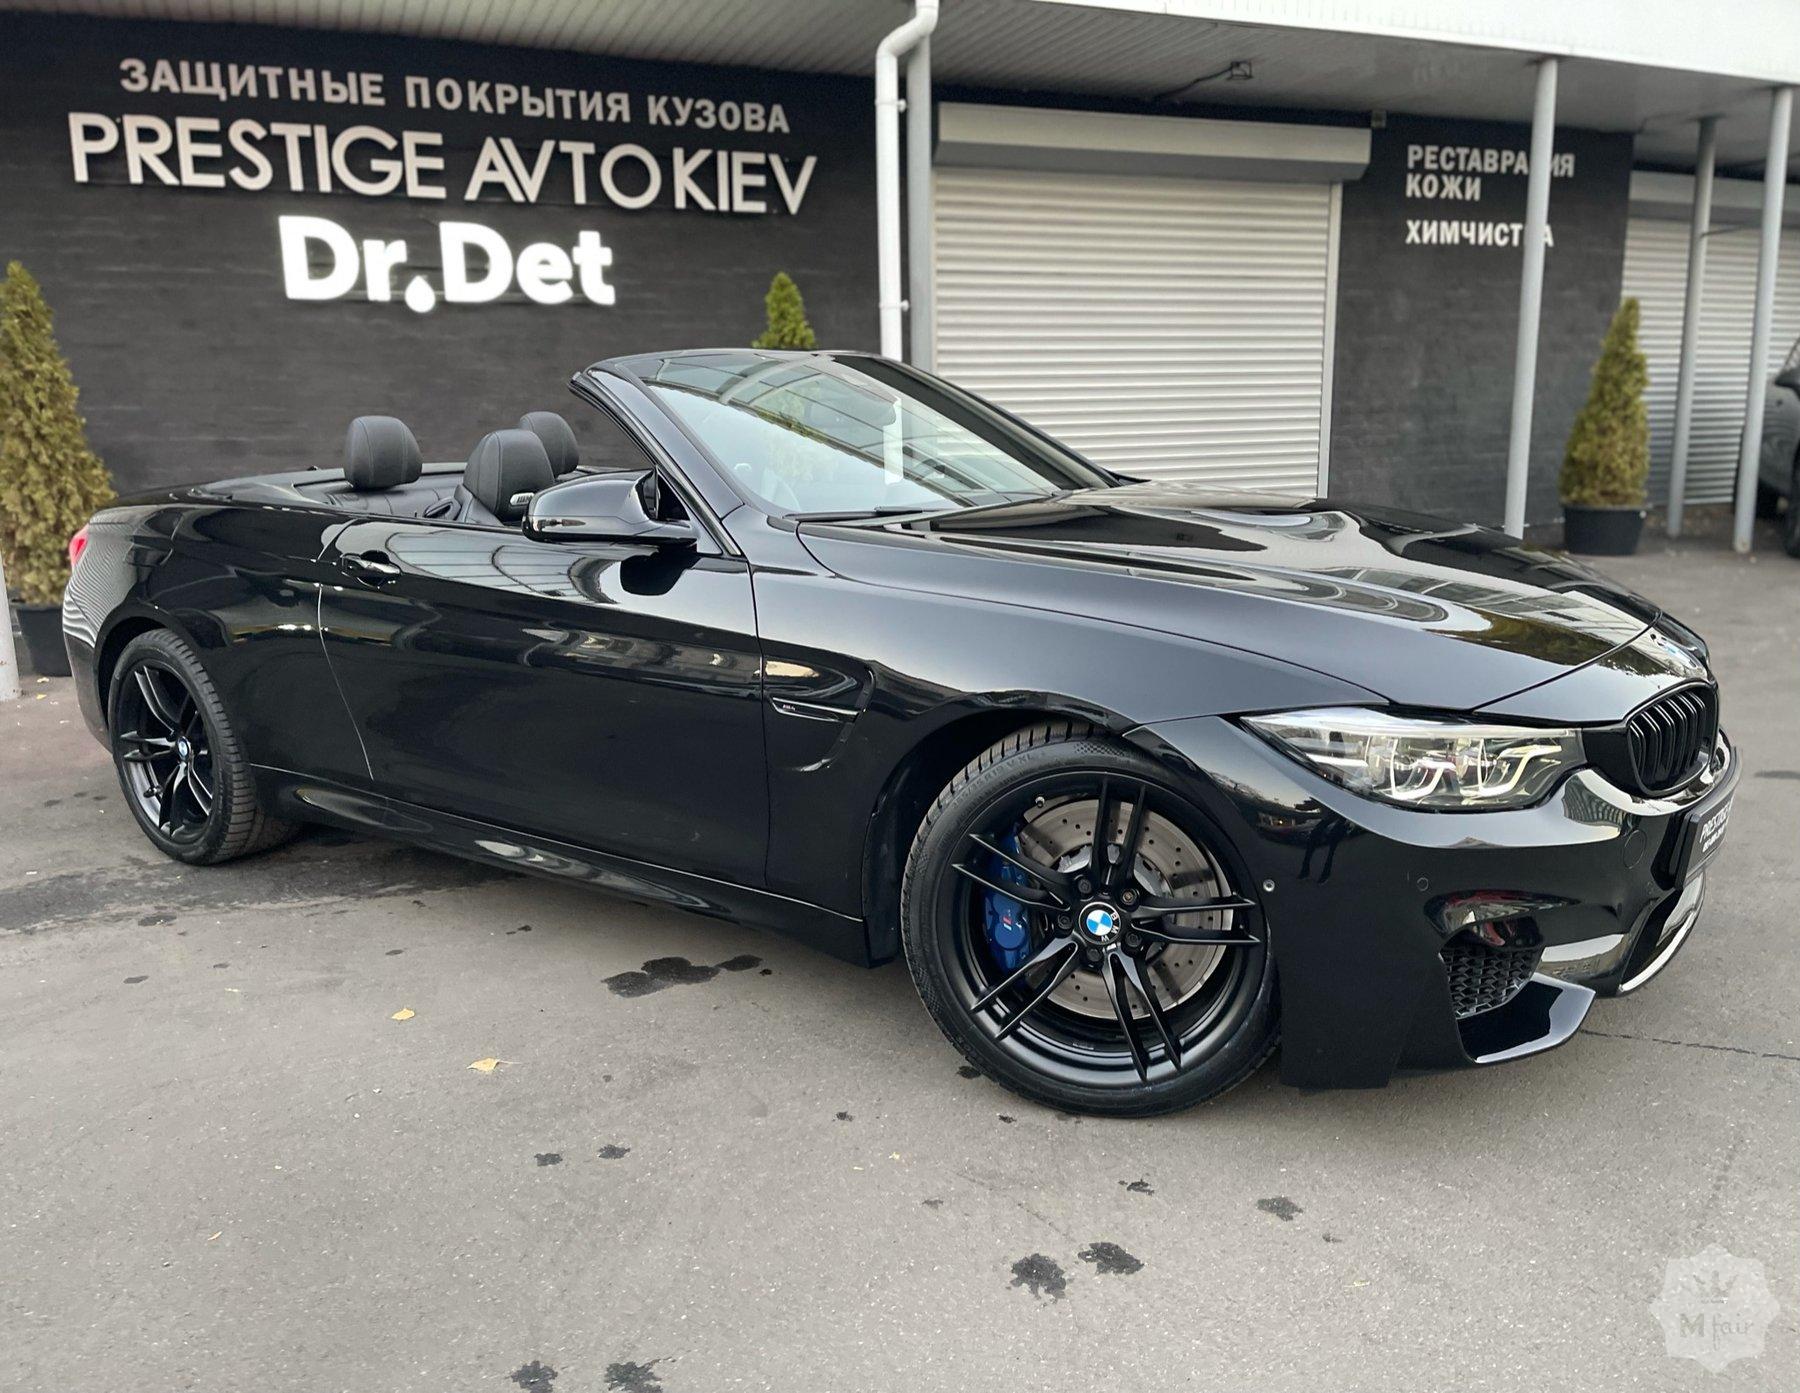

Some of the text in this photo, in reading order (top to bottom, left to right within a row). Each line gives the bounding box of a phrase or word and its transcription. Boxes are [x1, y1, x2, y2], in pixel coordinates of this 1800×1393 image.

[119, 57, 790, 134] ЗАЩИТНЫЕ ПОКРЫТИЯ КУЗОВА
[68, 111, 447, 198] PRESTIGE
[1407, 144, 1576, 178] РЕСТАВРАИЯ
[1405, 173, 1482, 201] КОЖИ
[1405, 219, 1555, 248] ХИМЧИСТА
